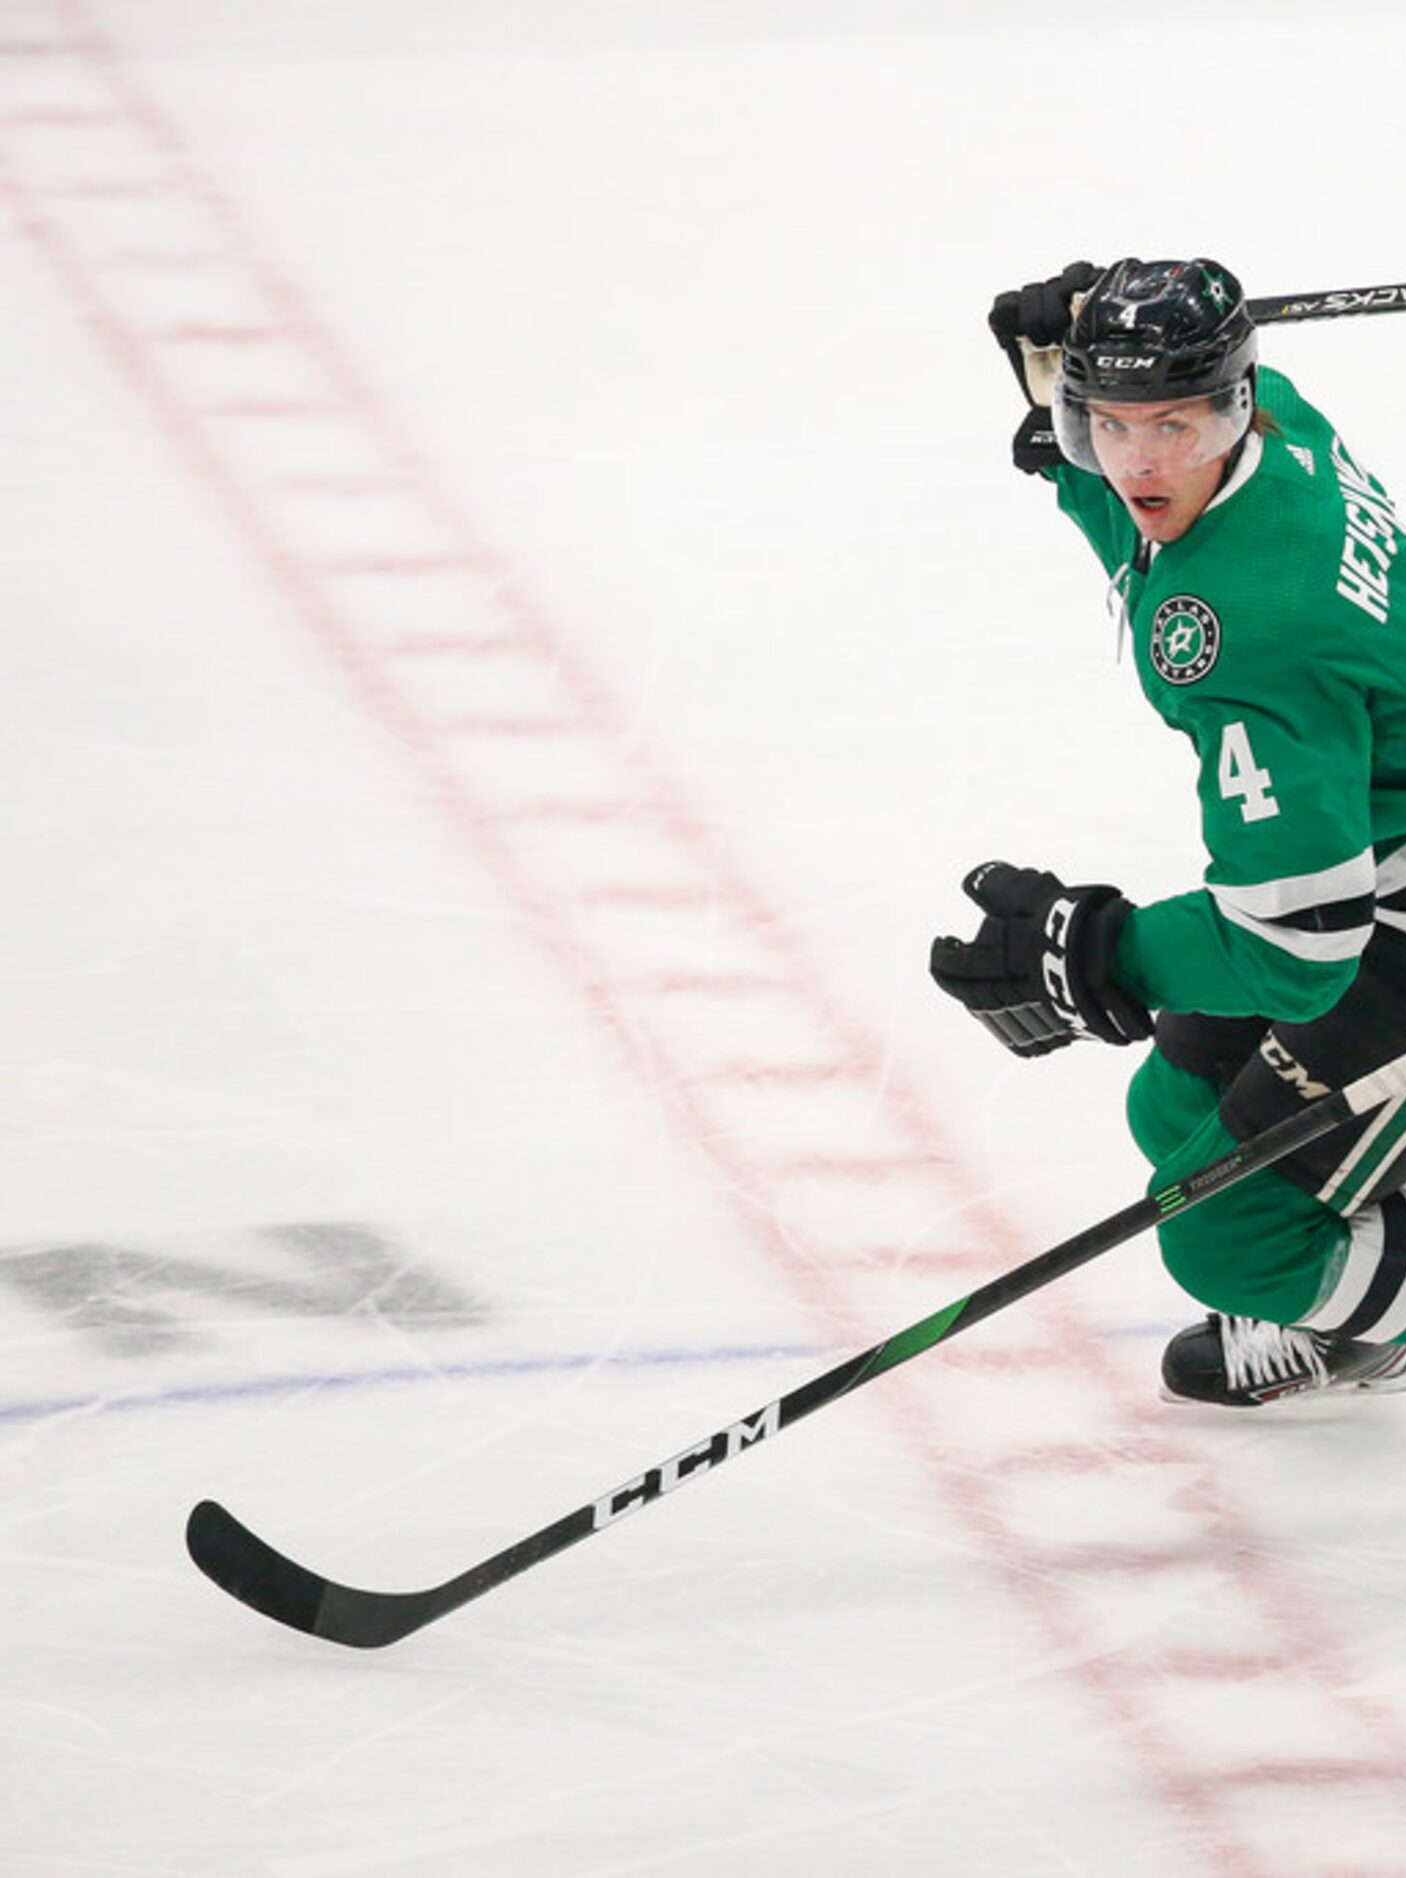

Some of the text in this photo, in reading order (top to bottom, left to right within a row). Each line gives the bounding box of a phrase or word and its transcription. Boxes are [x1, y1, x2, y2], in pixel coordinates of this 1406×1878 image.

[1119, 304, 1138, 330] 4
[1096, 356, 1157, 369] CCM
[1218, 720, 1281, 824] 4
[593, 1397, 780, 1530] CCM
